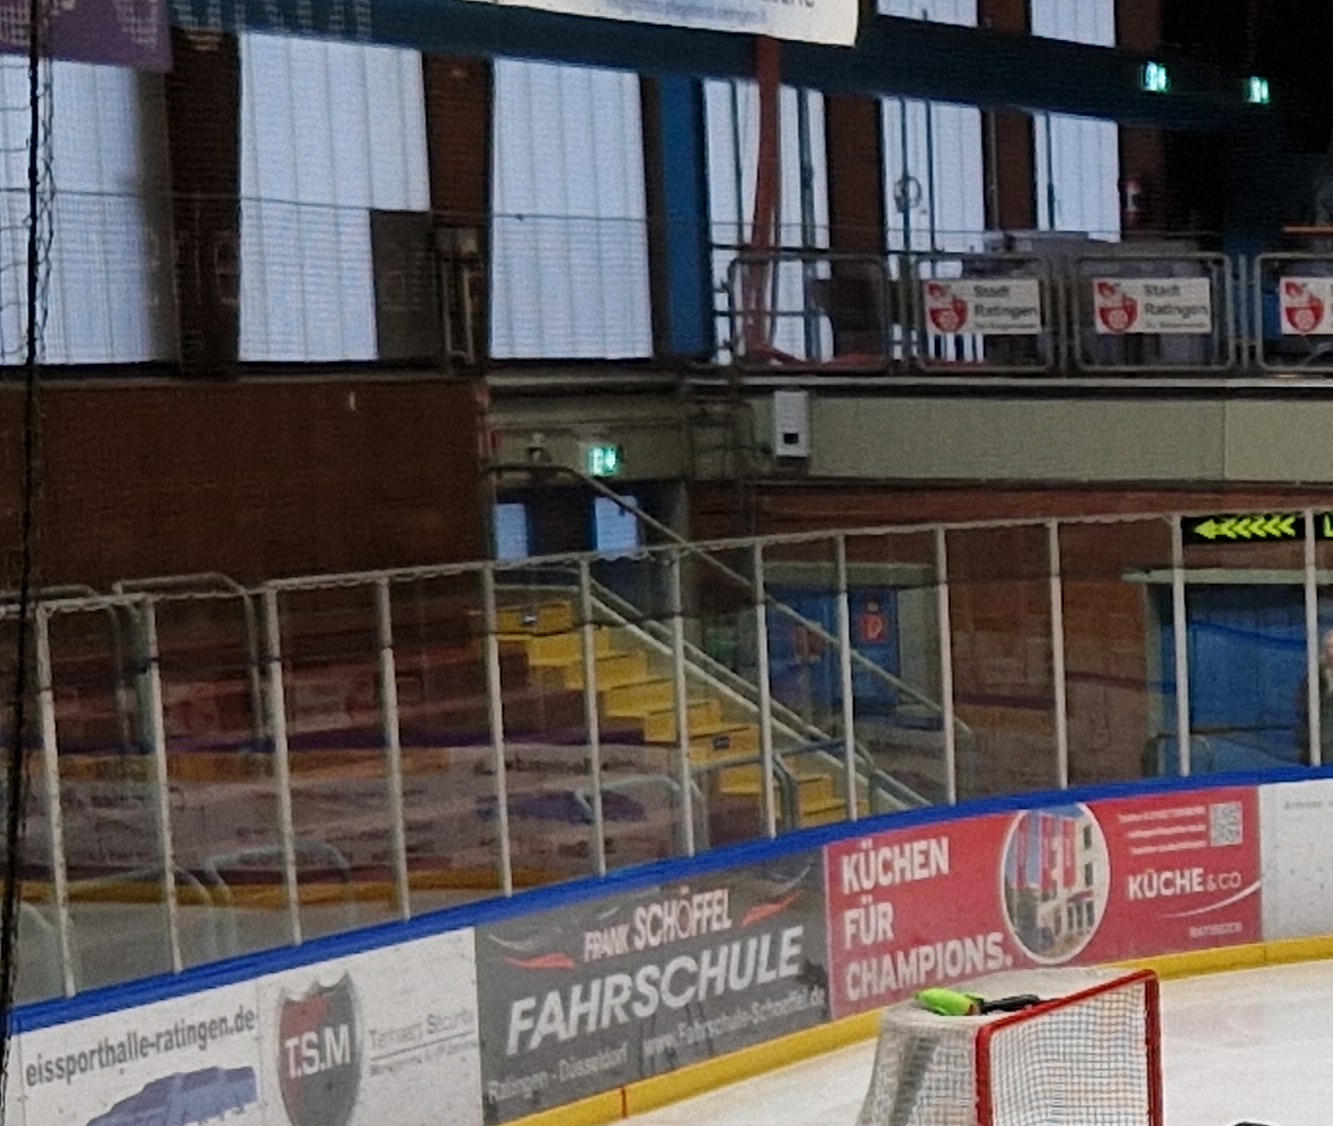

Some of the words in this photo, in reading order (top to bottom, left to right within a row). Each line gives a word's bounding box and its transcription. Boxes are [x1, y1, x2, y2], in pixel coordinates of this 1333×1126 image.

[841, 834, 950, 895] KÜCHEN
[583, 922, 632, 963] FRANK
[632, 884, 733, 951] SCHÖFFEL
[843, 894, 894, 951] FÜR
[506, 925, 805, 1056] FAHRSCHULE
[846, 931, 1014, 1001] CHAMPIONS.
[25, 1003, 256, 1088] eissporthalle-ratingen.de
